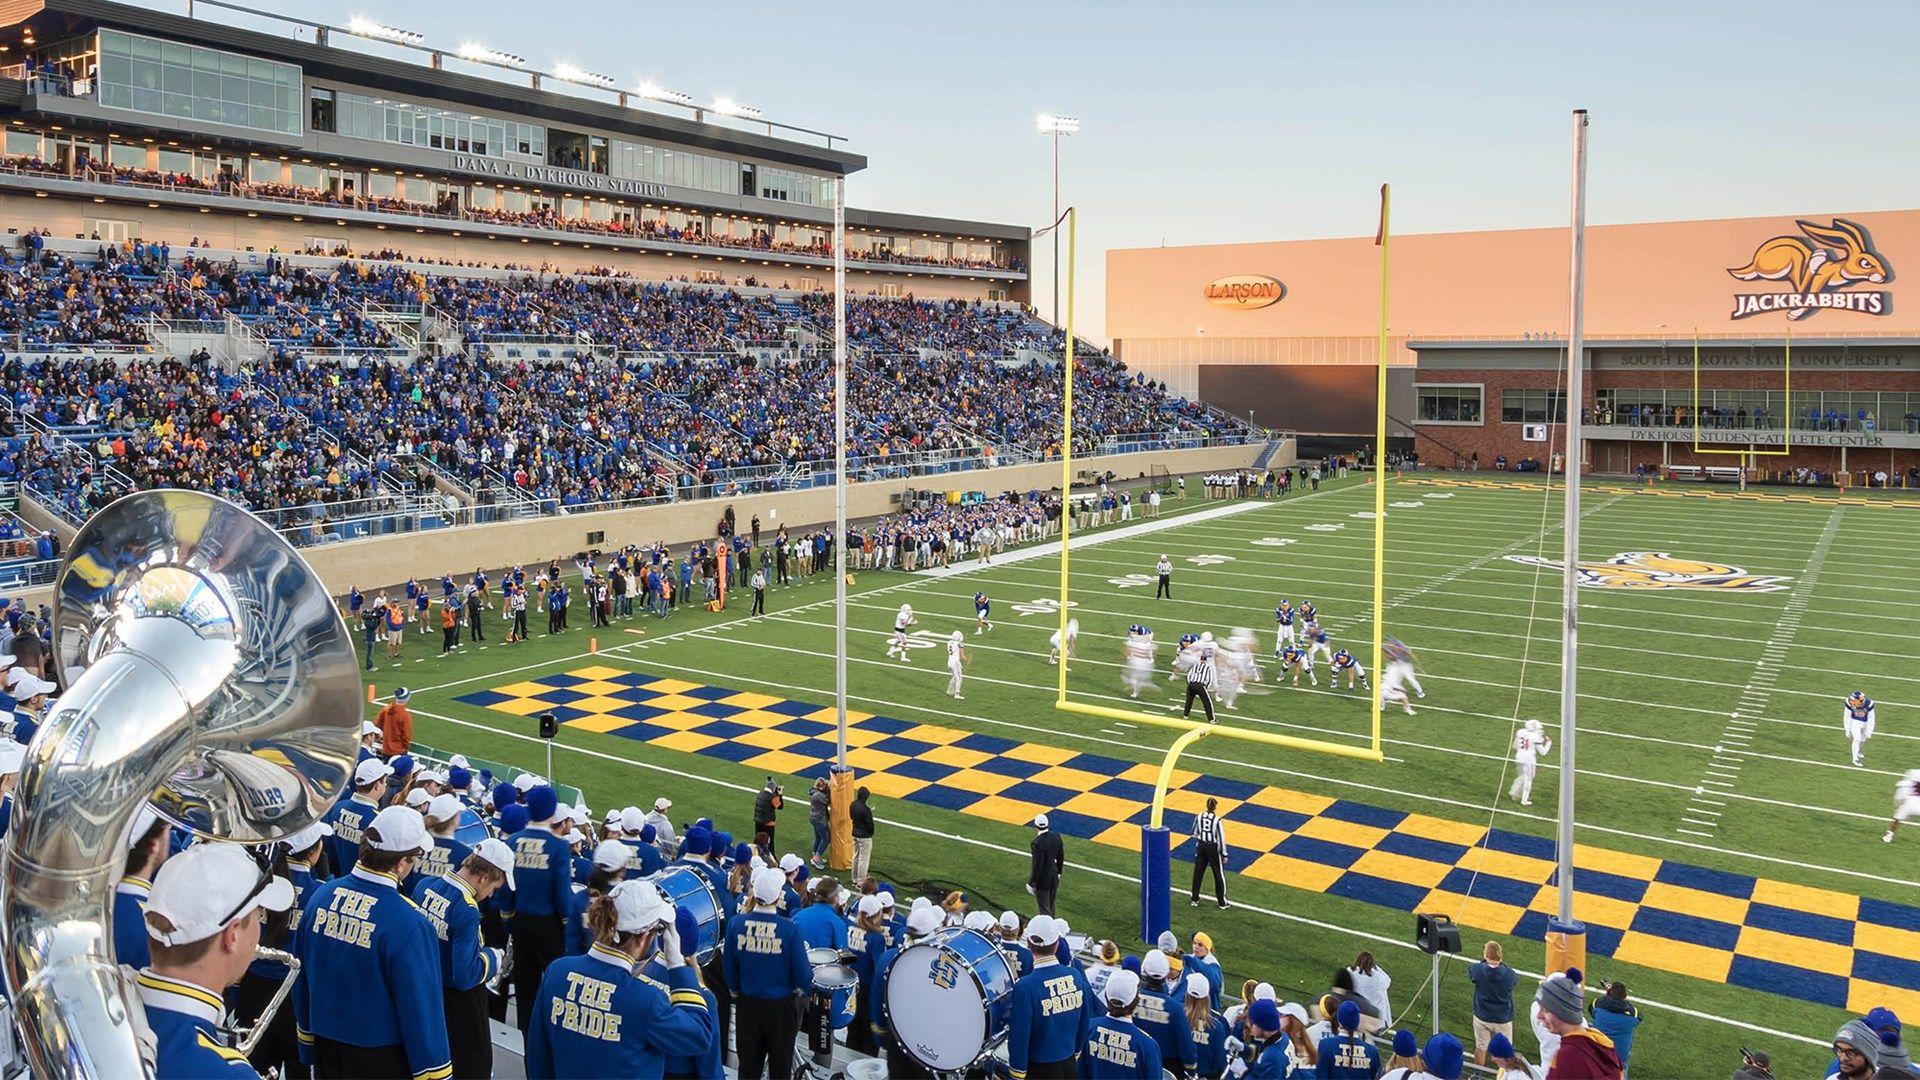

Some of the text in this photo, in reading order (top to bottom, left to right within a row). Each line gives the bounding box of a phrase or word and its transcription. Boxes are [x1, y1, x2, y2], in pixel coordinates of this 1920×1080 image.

[455, 155, 668, 198] DANA J. DYKHOUSE STADIUM
[1208, 282, 1275, 304] LARSON
[1733, 293, 1882, 317] JACKRABBITS
[1620, 354, 1670, 366] SOUTH
[1800, 353, 1905, 366] UNIVERSITY
[1631, 430, 1697, 441] DYKHOUSE
[1829, 435, 1884, 447] CENTER
[330, 887, 379, 920] THE
[421, 888, 451, 920] THE
[313, 907, 377, 949] PRIDE
[744, 920, 777, 938] THE
[737, 934, 783, 954] PRIDE
[567, 971, 617, 1012] THE
[1043, 975, 1077, 998] THE
[1041, 990, 1083, 1016] PRIDE
[551, 996, 623, 1042] PRIDE
[1097, 1026, 1132, 1050] THE
[1089, 1040, 1138, 1068] PRIDE
